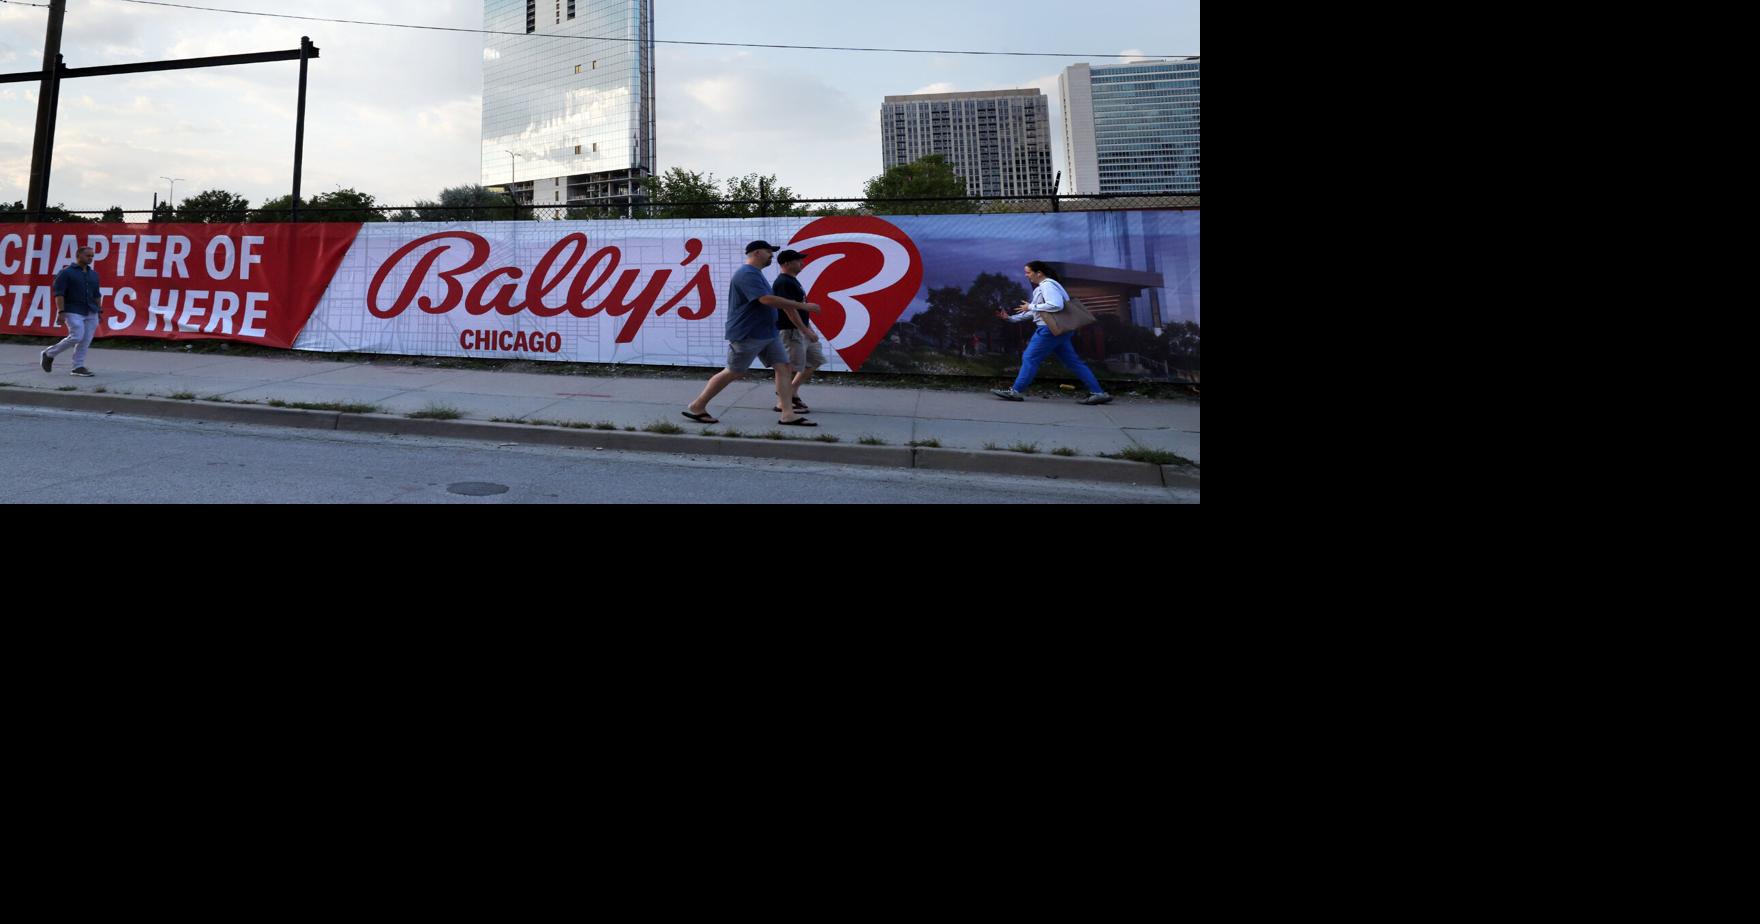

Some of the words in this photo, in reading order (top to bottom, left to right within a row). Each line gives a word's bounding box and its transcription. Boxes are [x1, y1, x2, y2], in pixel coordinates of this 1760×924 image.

[0, 233, 191, 279] CHAPTER
[205, 235, 265, 281] OF
[0, 285, 137, 331] TAS
[145, 288, 269, 337] HERE
[366, 230, 716, 344] Bally's
[460, 329, 561, 353] CHICAGO
